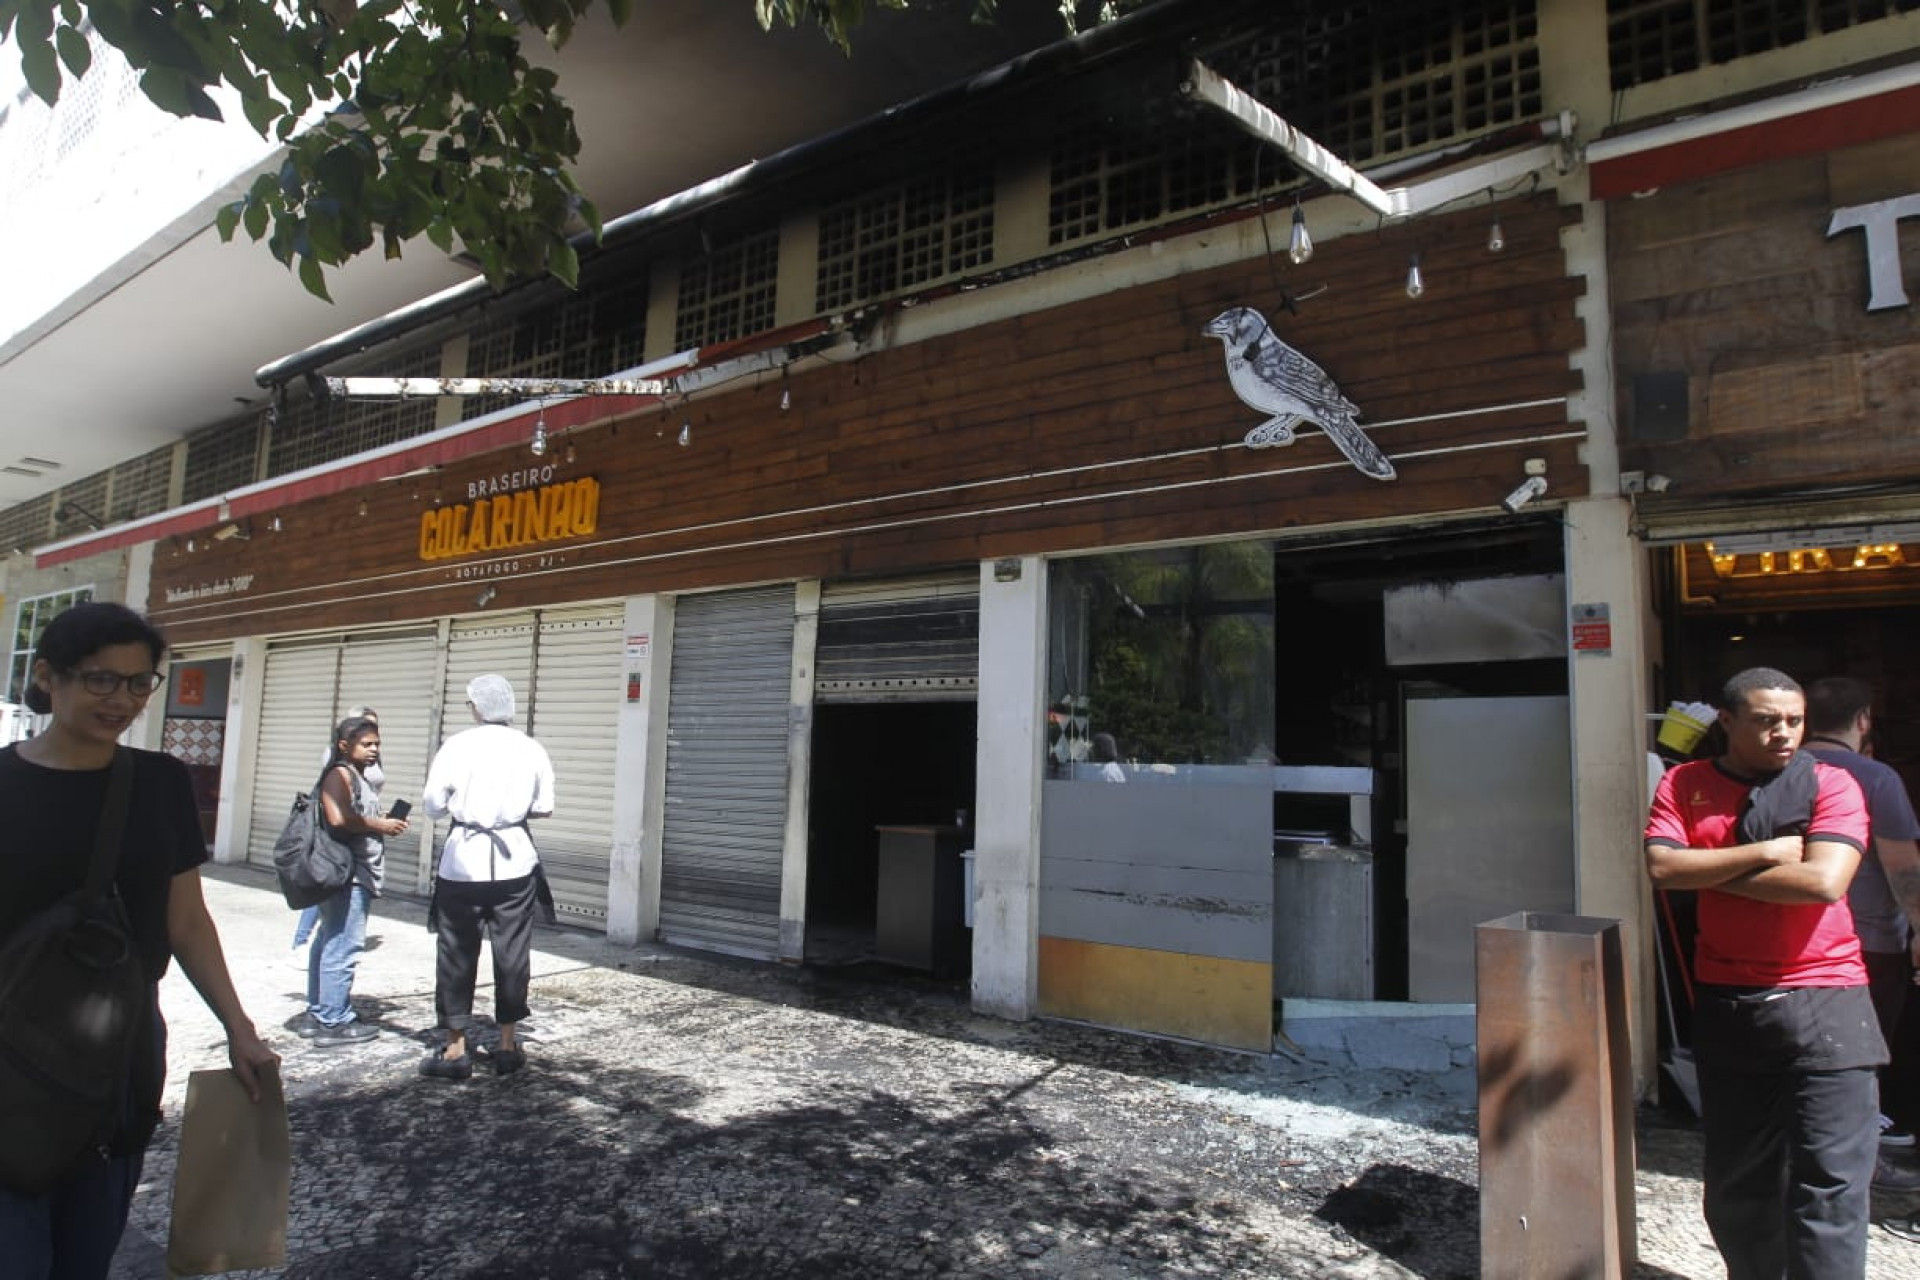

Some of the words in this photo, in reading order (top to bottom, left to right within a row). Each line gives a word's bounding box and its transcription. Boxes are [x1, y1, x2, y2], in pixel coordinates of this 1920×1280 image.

[468, 465, 553, 499] BRASEIRO
[420, 477, 600, 560] COLARINHO
[456, 561, 519, 578] BOTAFOGO
